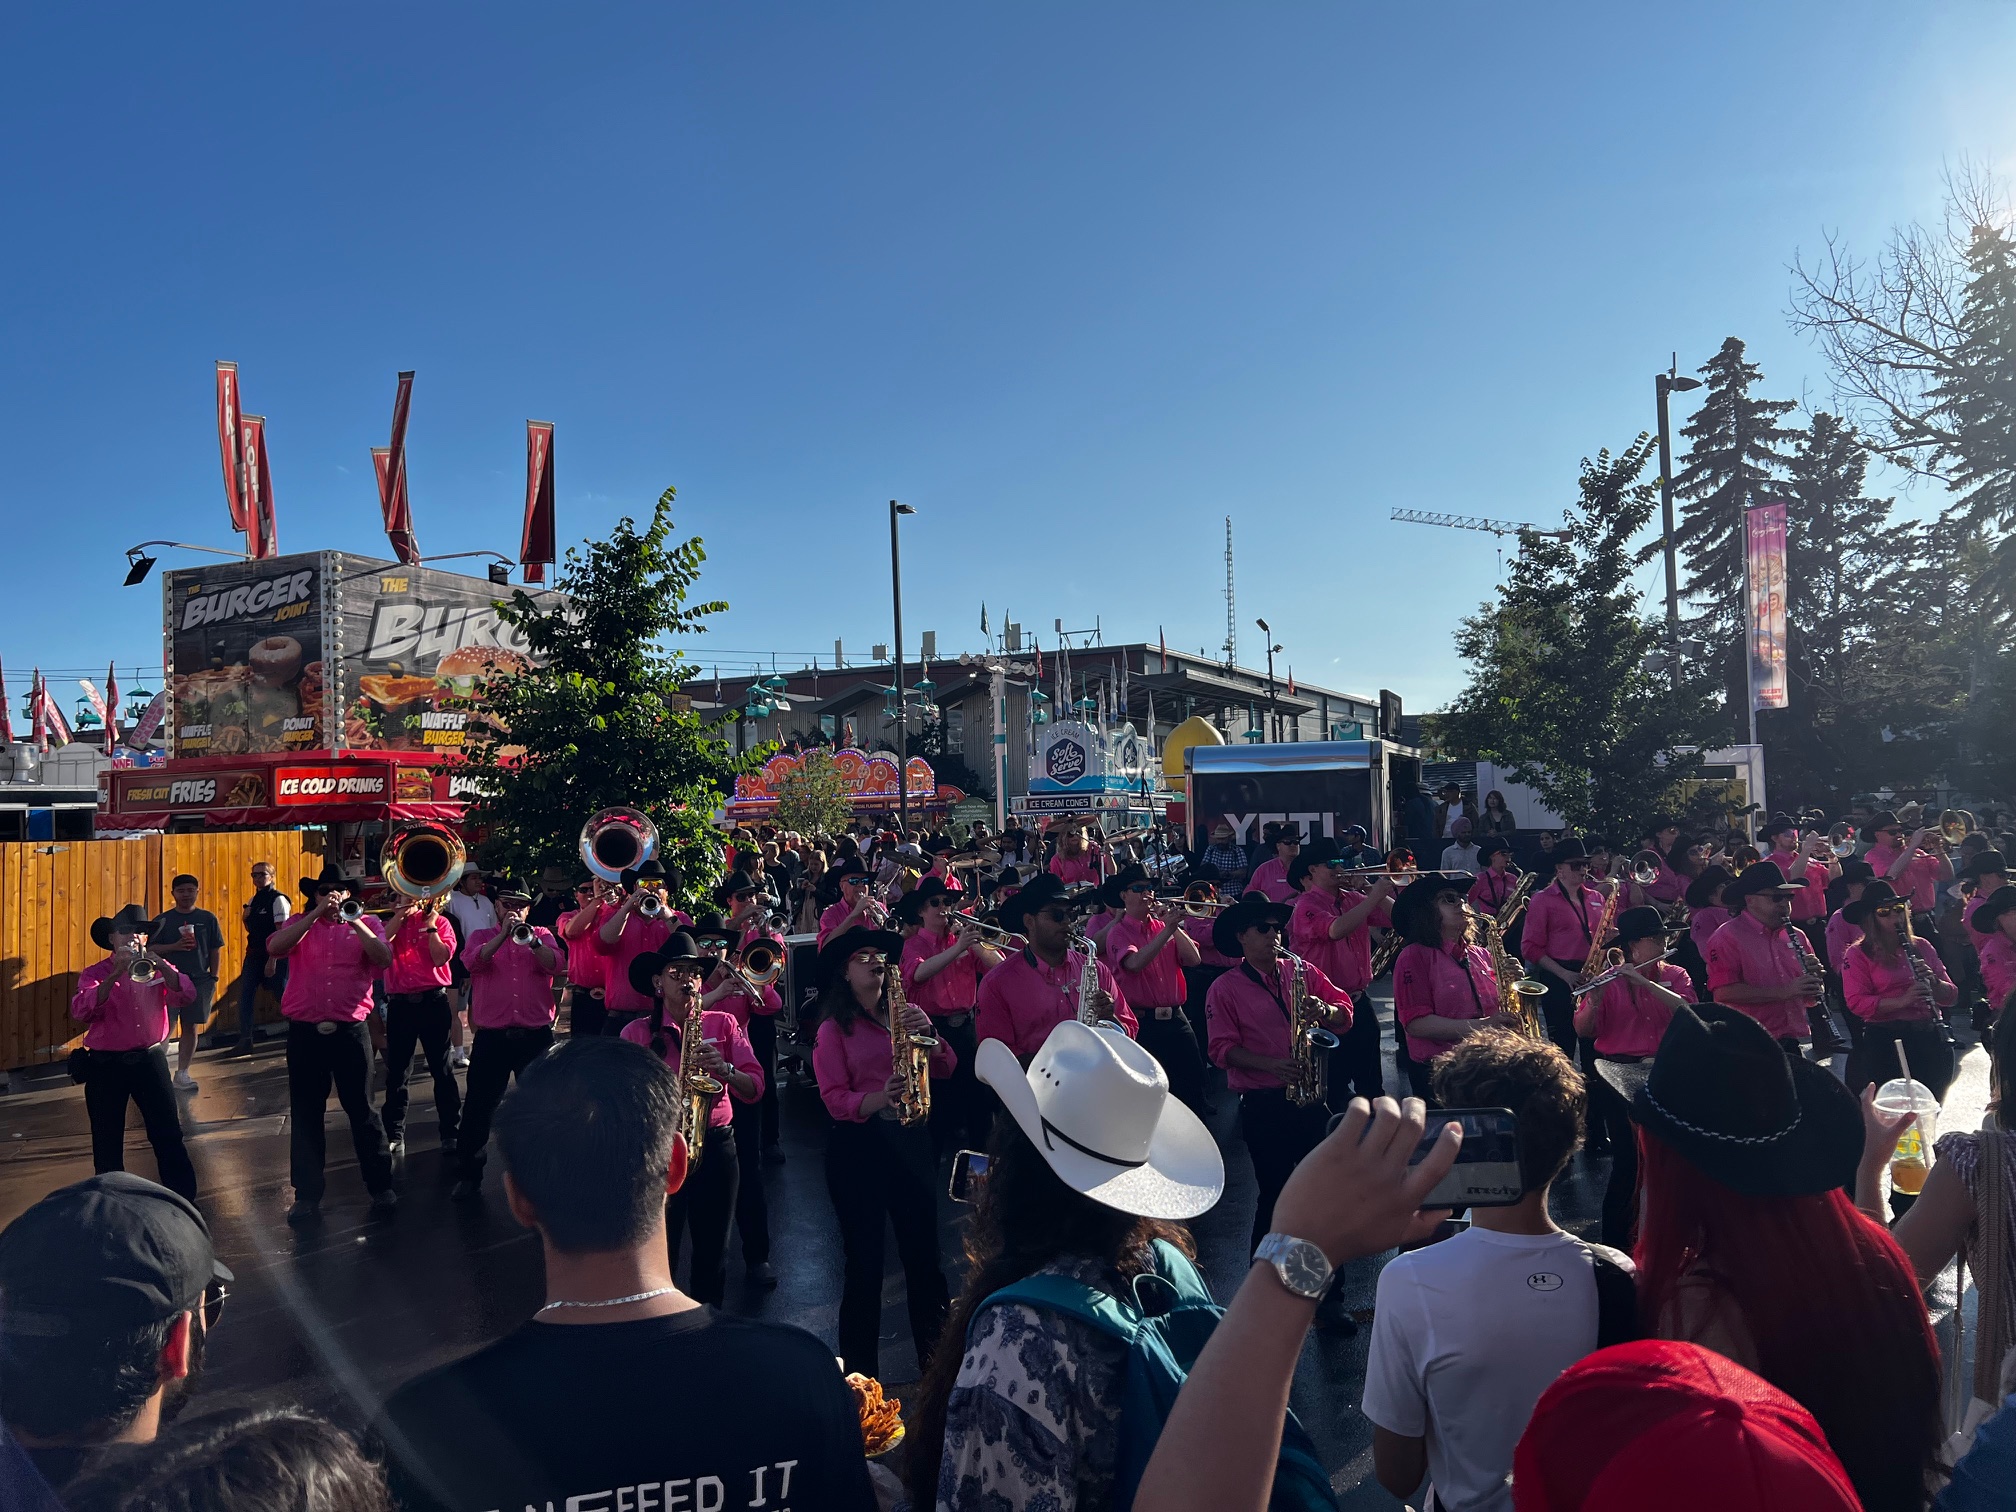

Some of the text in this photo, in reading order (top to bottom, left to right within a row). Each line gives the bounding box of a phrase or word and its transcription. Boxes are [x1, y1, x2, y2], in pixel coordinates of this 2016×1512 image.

[187, 584, 201, 595] THE
[381, 577, 409, 593] THE
[181, 570, 313, 631] BURGER
[273, 600, 311, 623] JOINT
[369, 604, 590, 660] BURG
[283, 716, 315, 731] DONUT
[421, 712, 467, 730] WAFFLE
[180, 724, 213, 739] WAFFLE
[283, 730, 314, 743] BURGER
[423, 730, 467, 746] BURGER
[1060, 728, 1080, 740] CREAM
[182, 737, 212, 750] BURGER
[1051, 741, 1078, 764] Soft
[1050, 755, 1083, 776] Serve
[127, 779, 217, 804] FRESH CUT FRIES
[279, 777, 385, 795] ICE COLD DRINKS
[1030, 798, 1089, 808] ICE CREAM CONES
[749, 1459, 798, 1507] IT
